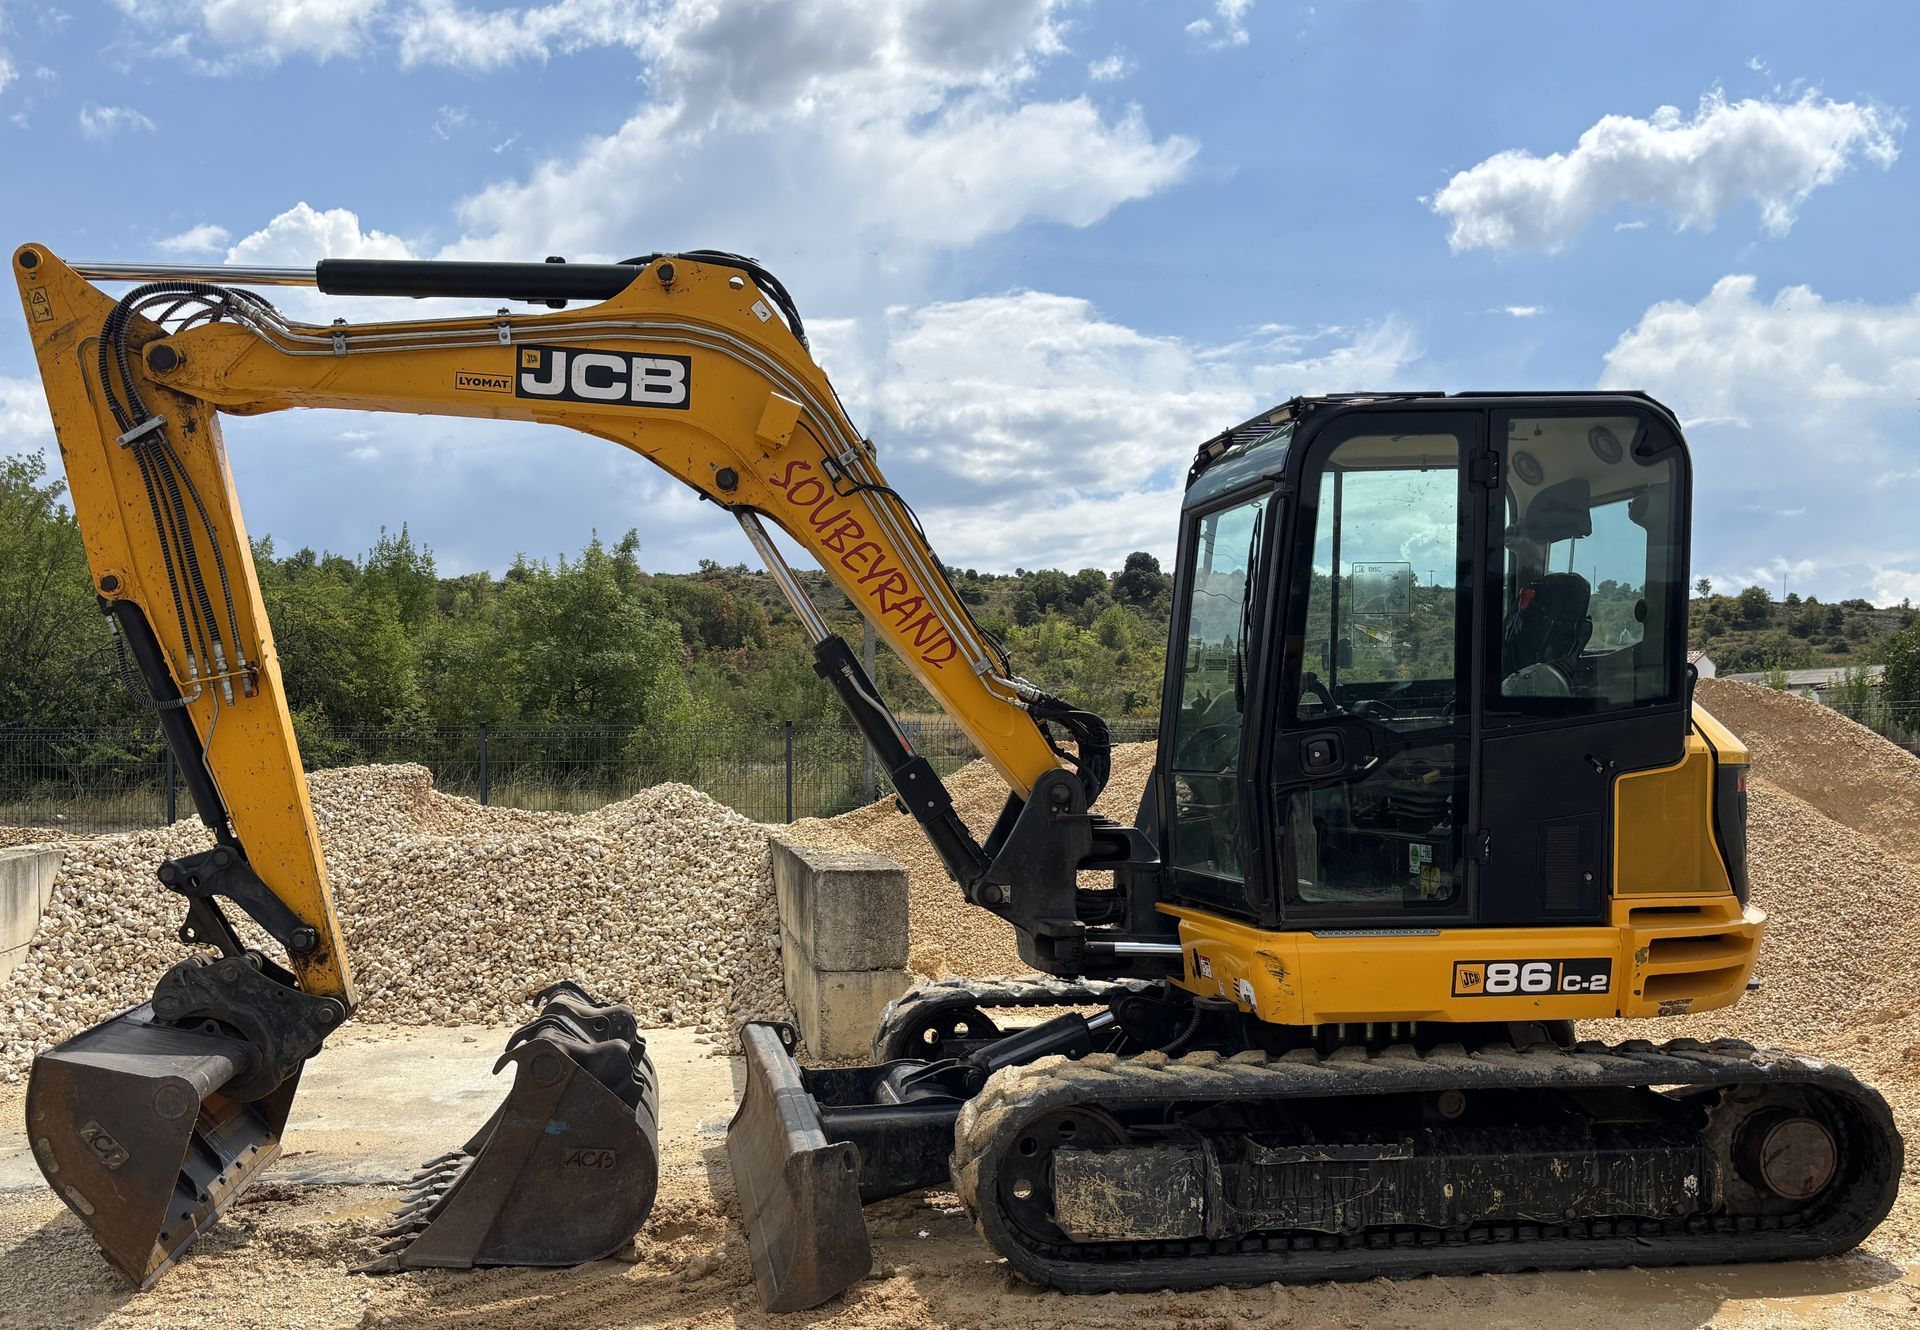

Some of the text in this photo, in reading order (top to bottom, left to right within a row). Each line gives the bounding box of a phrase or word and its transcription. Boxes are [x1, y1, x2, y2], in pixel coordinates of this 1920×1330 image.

[458, 376, 509, 389] LYOMAT
[521, 351, 686, 404] JCB
[768, 460, 958, 670] SOUBEYRAND
[1463, 971, 1480, 986] JCB
[1485, 962, 1608, 994] 86 C-2
[563, 1150, 614, 1168] ACB
